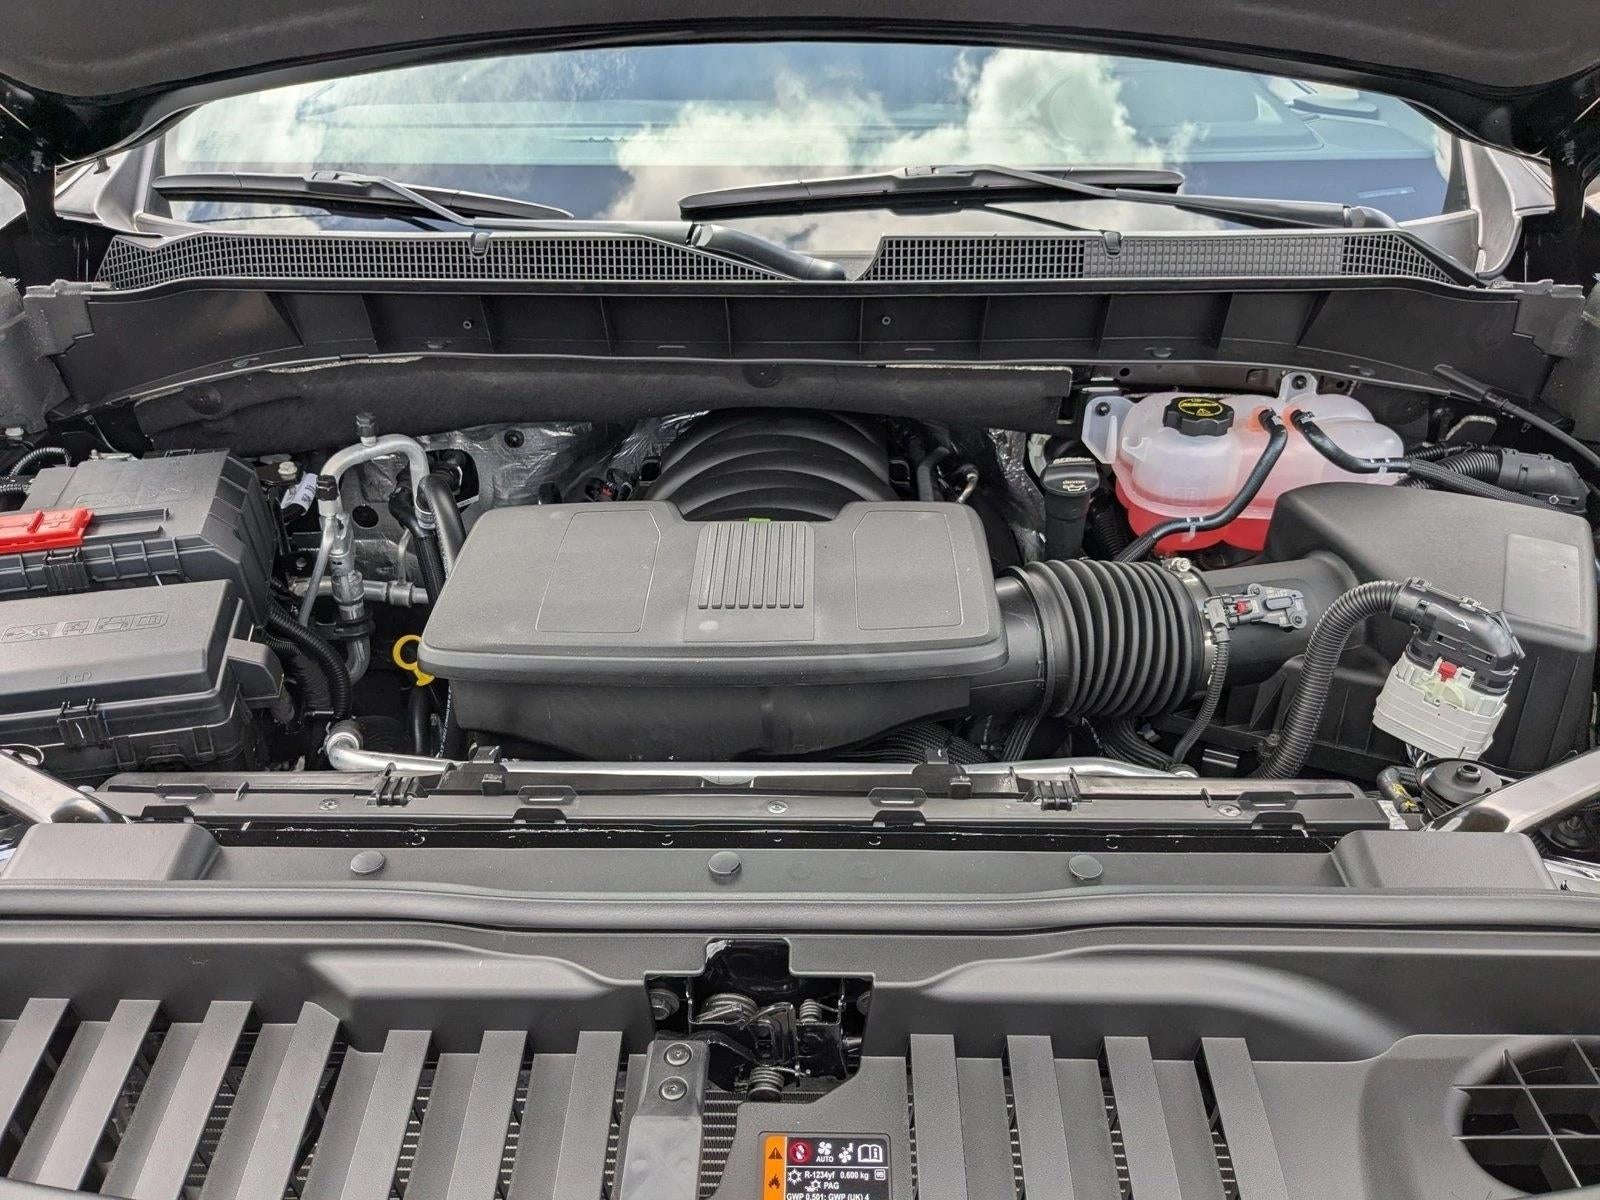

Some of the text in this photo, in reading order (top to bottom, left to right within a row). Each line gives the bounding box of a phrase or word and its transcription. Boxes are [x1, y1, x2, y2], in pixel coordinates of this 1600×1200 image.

[804, 1171, 835, 1180] R-1234yf
[840, 1171, 859, 1180] 0.600
[860, 1172, 869, 1180] kg
